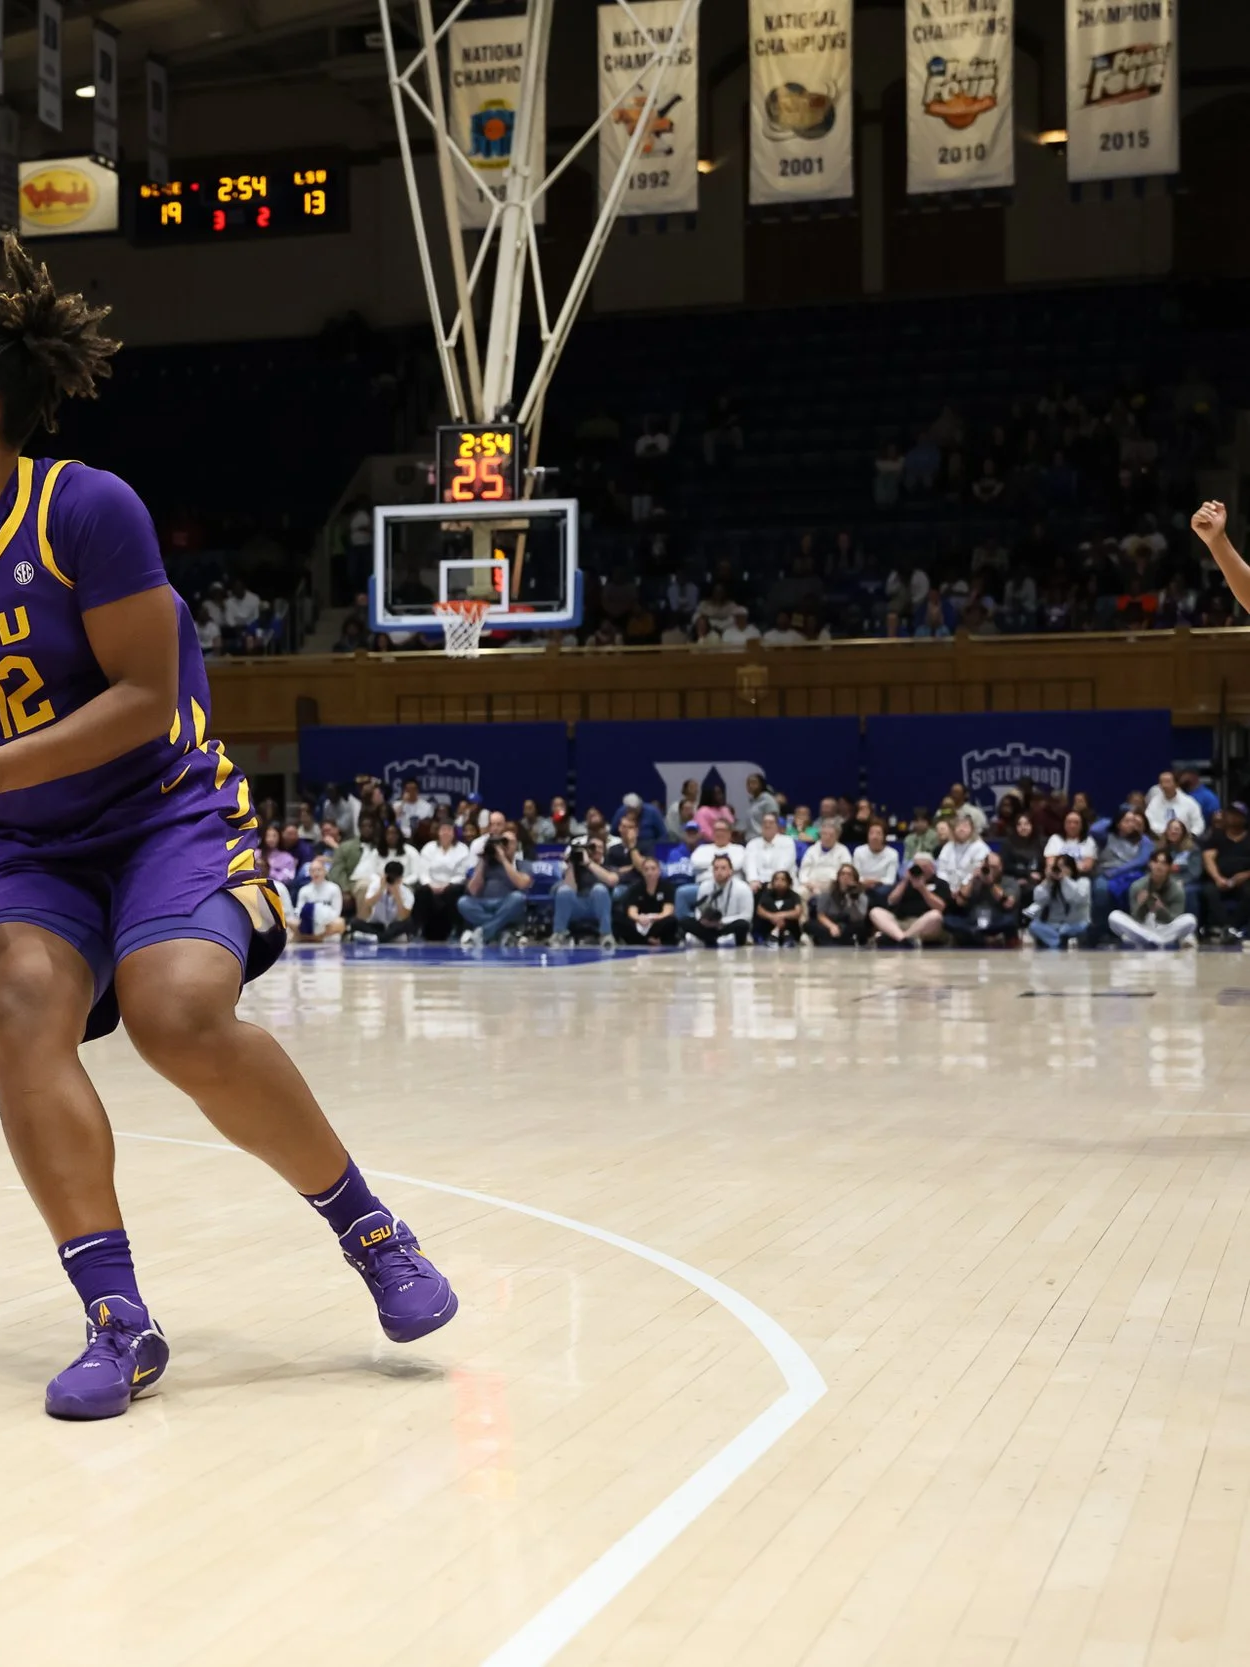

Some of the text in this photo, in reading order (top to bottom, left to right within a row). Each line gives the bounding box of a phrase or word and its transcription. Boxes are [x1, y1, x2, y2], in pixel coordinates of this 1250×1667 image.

[613, 27, 683, 48] NATIONA
[461, 43, 523, 64] NATIONA
[453, 66, 521, 88] CHAMPIO
[1100, 129, 1150, 152] 2015
[938, 143, 987, 165] 2010
[779, 157, 824, 177] 2001
[217, 175, 267, 202] 2:54
[629, 170, 671, 190] 1992
[161, 201, 182, 225] 19
[304, 190, 326, 215] 13
[213, 209, 226, 231] 3
[256, 206, 271, 228] 2
[459, 432, 512, 458] 2:54
[451, 457, 504, 501] 25
[14, 562, 34, 584] SEC
[360, 1225, 392, 1247] LSU
